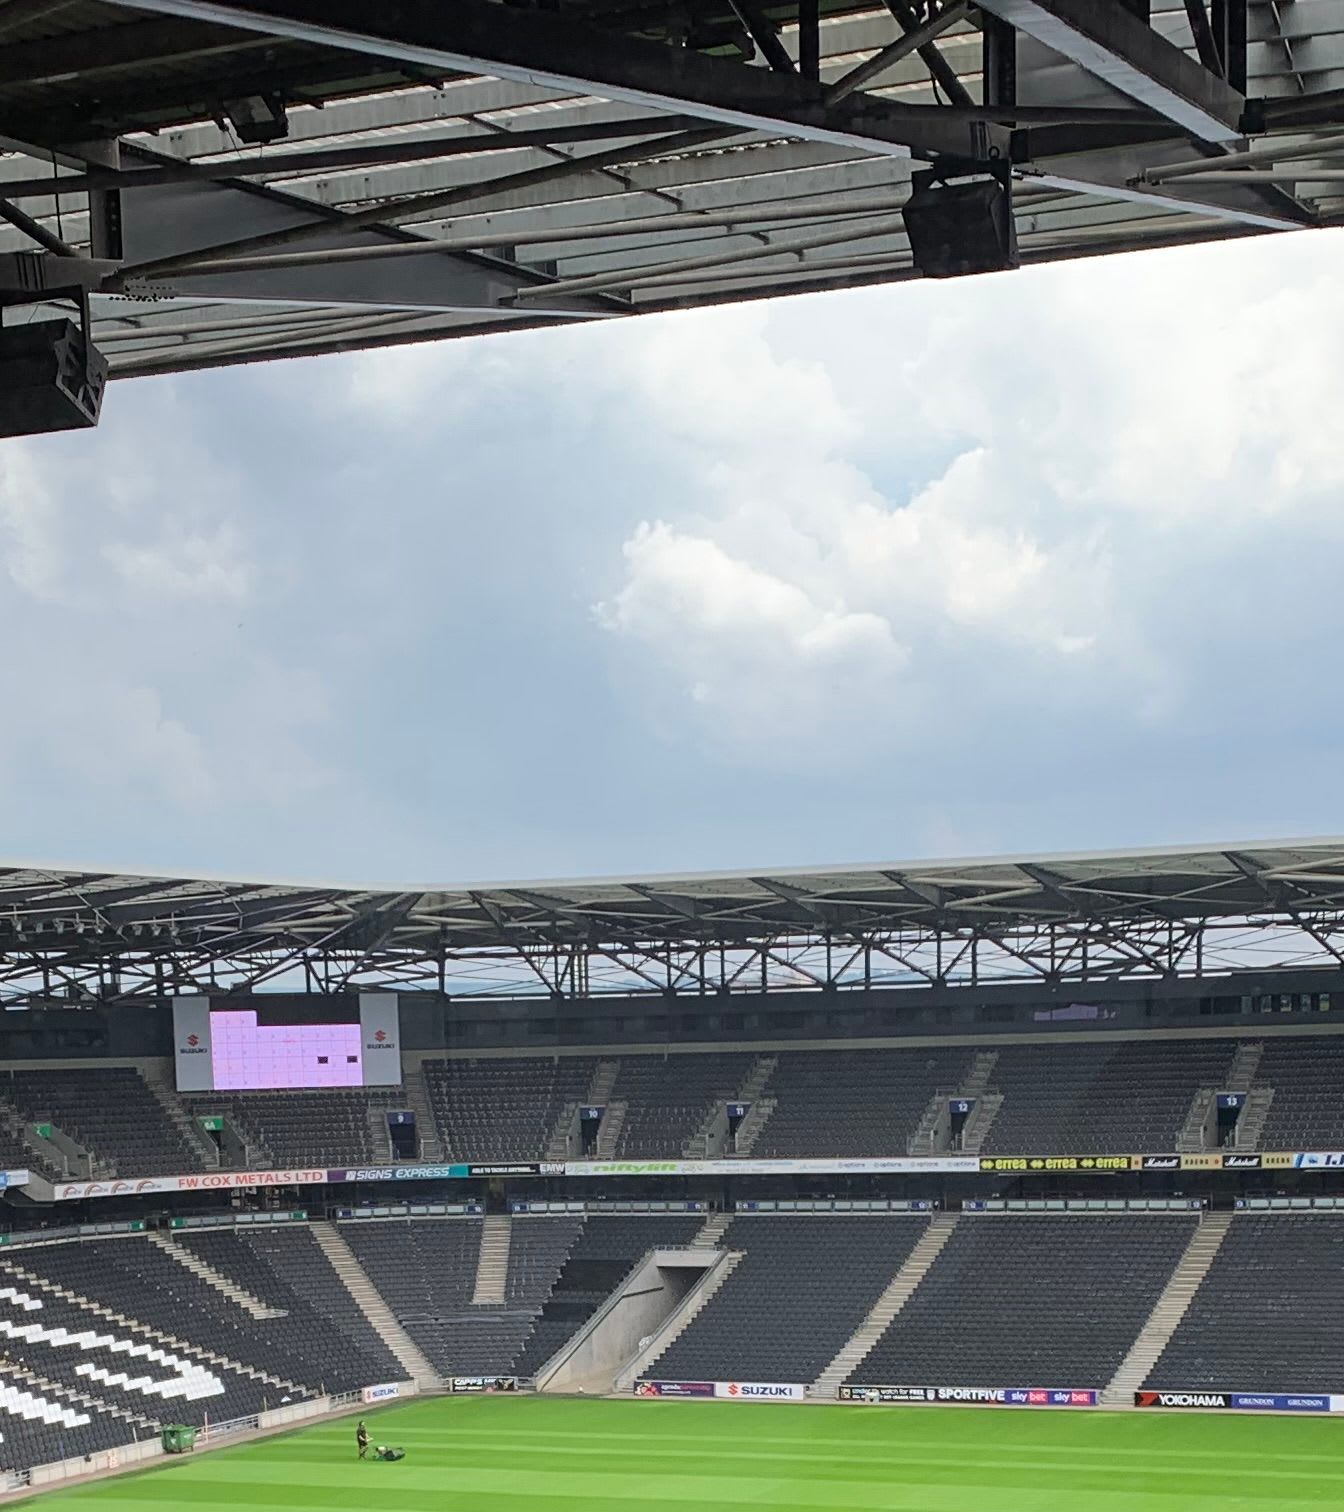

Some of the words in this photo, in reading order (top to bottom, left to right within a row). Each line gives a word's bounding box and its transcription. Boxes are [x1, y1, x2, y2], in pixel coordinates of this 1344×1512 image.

[958, 1103, 968, 1112] 12
[1227, 1097, 1238, 1106] 13
[589, 1110, 599, 1119] 10
[540, 1163, 565, 1173] EMW
[593, 1161, 678, 1173] niftylift
[995, 1158, 1027, 1170] errea
[1045, 1158, 1077, 1170] errea
[1095, 1157, 1127, 1169] errea
[356, 1168, 392, 1180] SIGNS
[396, 1166, 449, 1178] EXPRESS
[178, 1178, 199, 1188] FW
[202, 1175, 230, 1187] COX
[235, 1172, 291, 1185] METALS
[296, 1171, 323, 1182] LTD
[741, 1386, 793, 1396] SUZUKI
[938, 1388, 1005, 1400] SPORTFIVE
[1012, 1391, 1027, 1402] sky
[1029, 1391, 1045, 1401] bet
[1054, 1391, 1070, 1403] sky
[1072, 1392, 1088, 1402] bet
[1159, 1394, 1225, 1406] YOKOHAMA
